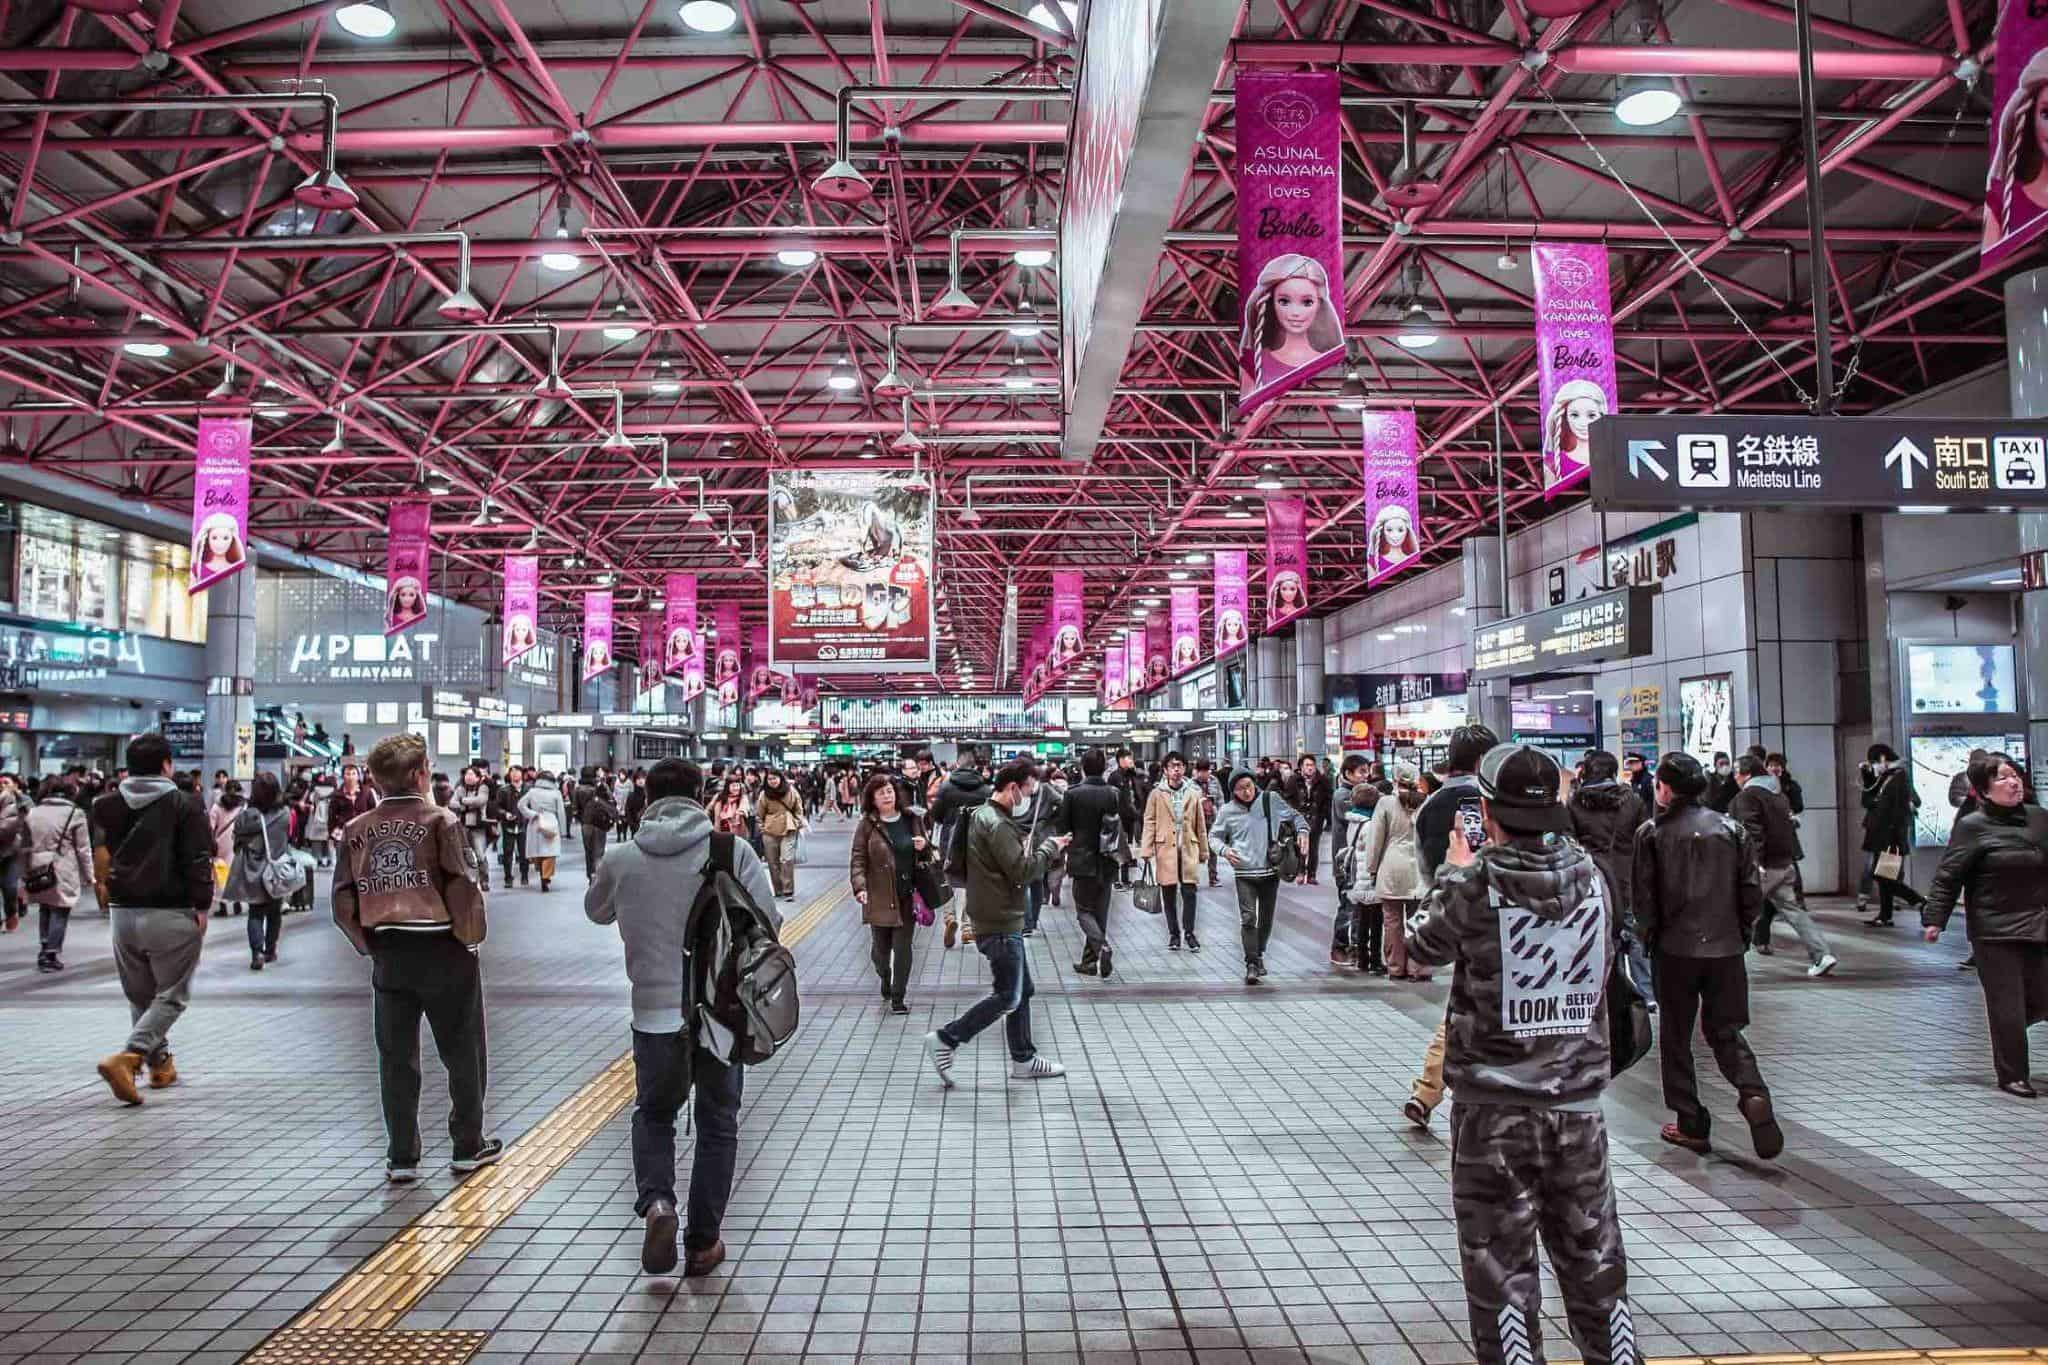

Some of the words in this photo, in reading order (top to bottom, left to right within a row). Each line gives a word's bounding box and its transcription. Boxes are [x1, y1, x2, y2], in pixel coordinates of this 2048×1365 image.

[1254, 145, 1325, 160] ASUNAL
[1243, 162, 1336, 178] KANAYAMA
[1268, 183, 1312, 200] loves
[1257, 206, 1326, 239] Barbie
[1553, 344, 1603, 370] Barbie
[1736, 434, 1820, 467] 名鉄線
[1933, 435, 1989, 468] 南口
[1999, 441, 2039, 455] TAXI
[1736, 468, 1791, 488] Meitetsu
[1793, 468, 1821, 488] Line
[1935, 469, 1967, 489] South
[1968, 470, 1989, 489] Exit
[350, 819, 428, 851] MASTER
[380, 852, 400, 868] 34
[358, 869, 432, 895] STROKE
[1508, 995, 1559, 1025] LOOK
[1561, 1007, 1586, 1020] YOU
